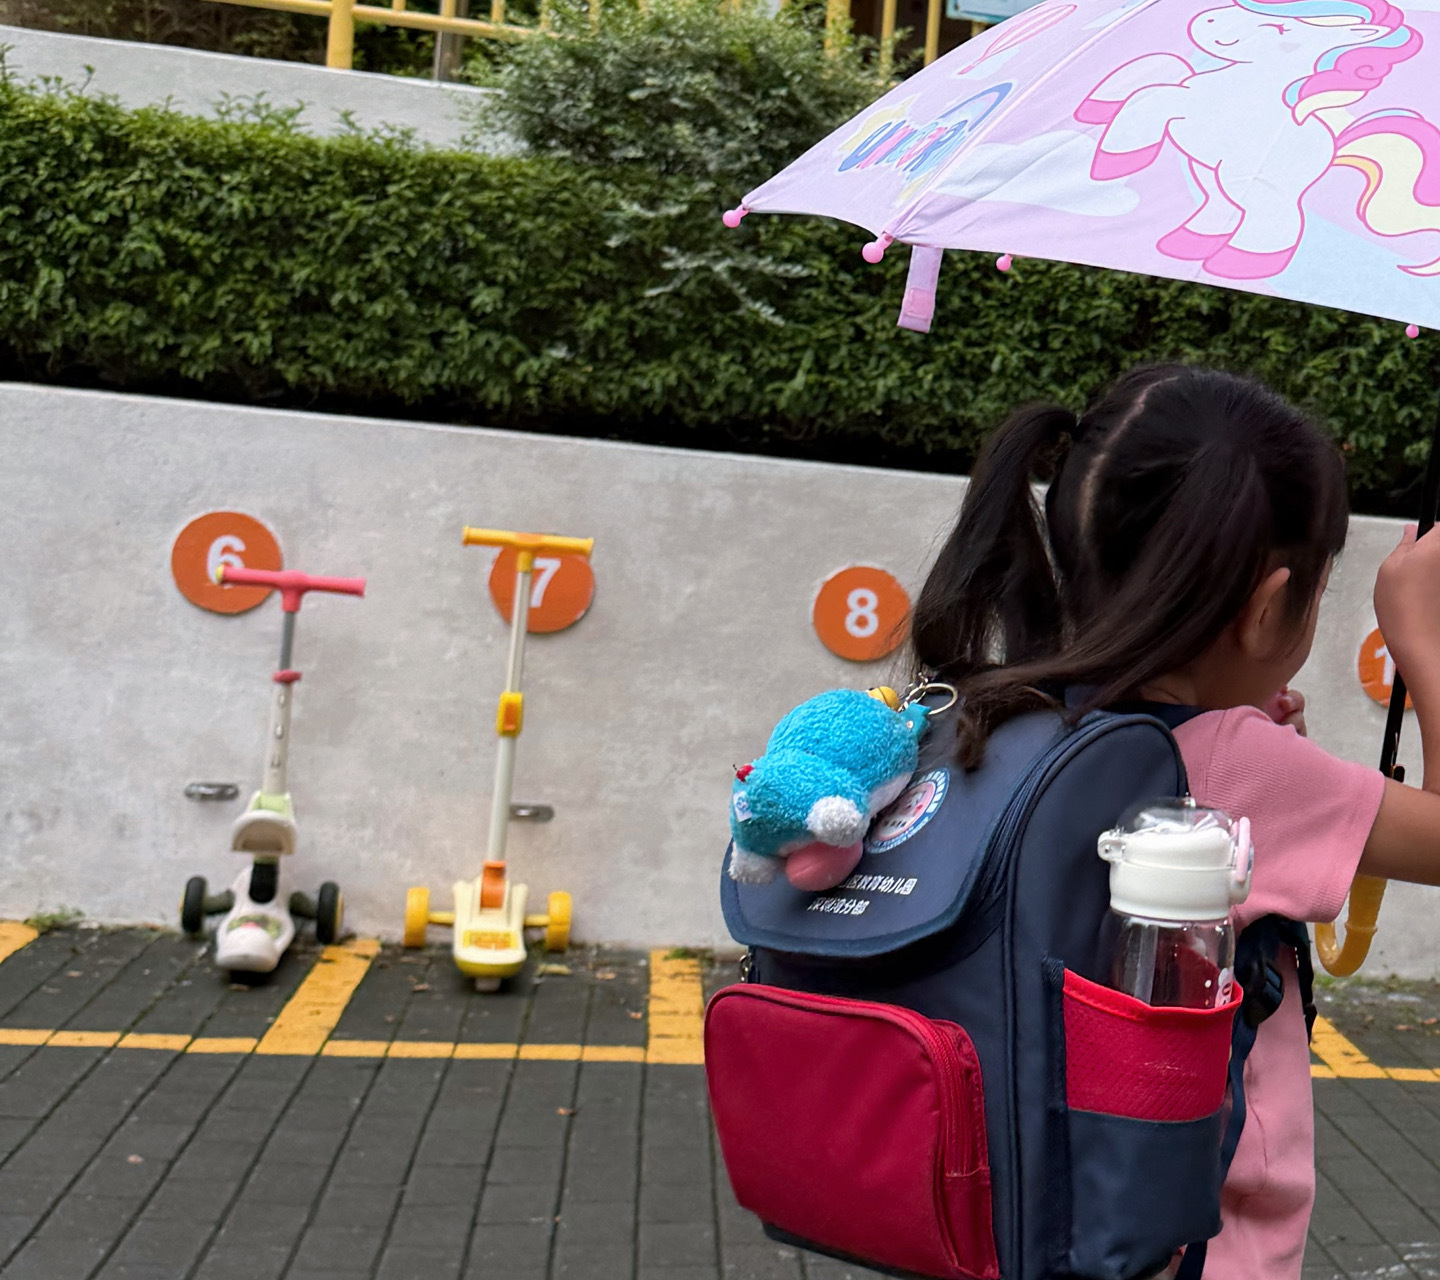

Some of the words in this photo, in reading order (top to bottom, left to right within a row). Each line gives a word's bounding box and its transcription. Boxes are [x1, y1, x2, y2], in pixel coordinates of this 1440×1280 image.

[207, 534, 246, 589] 6
[530, 556, 562, 608] 7
[844, 588, 879, 638] 8
[838, 873, 919, 895] 区教育幼儿园
